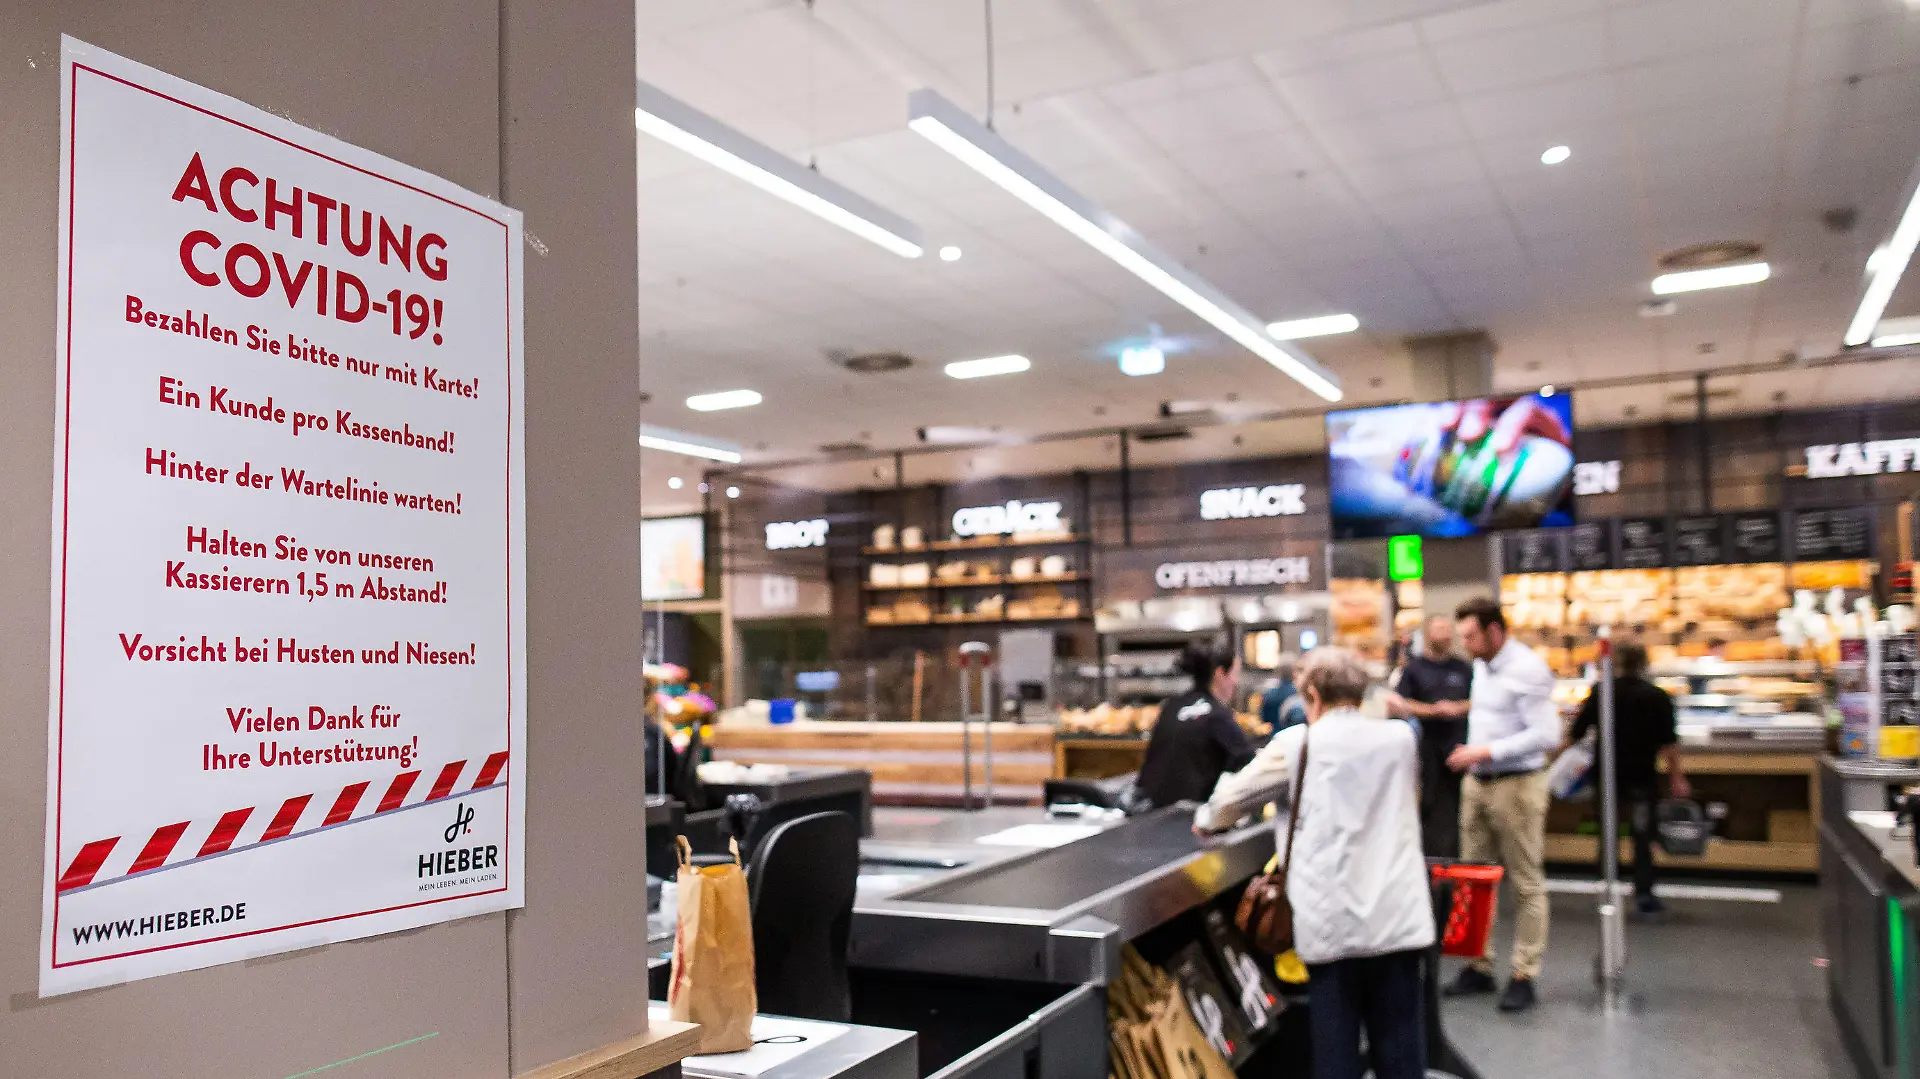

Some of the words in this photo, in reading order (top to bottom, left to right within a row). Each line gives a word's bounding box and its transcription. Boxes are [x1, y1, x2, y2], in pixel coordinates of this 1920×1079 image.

[172, 151, 448, 282] ACHTUNG
[179, 229, 444, 347] COVID-19!
[125, 294, 238, 347] Bezahlen
[246, 324, 281, 356] Sie
[288, 333, 340, 368] bitte
[346, 356, 380, 377] nur
[385, 362, 418, 387] mit
[423, 365, 479, 400] Karte!
[159, 375, 201, 409] Ein
[210, 385, 286, 425] Kunde
[292, 411, 329, 437] pro
[336, 409, 455, 455] Kassenband!
[1805, 438, 1920, 479] KAFF
[145, 447, 230, 484] Hinter
[235, 461, 274, 490] der
[280, 466, 389, 506] Wartelinie
[393, 491, 462, 515] warten!
[186, 525, 267, 559] Halten
[274, 534, 309, 562] Sie
[314, 548, 352, 567] von
[357, 552, 434, 573] unseren
[165, 560, 290, 595] Kassierern
[296, 571, 329, 603] 1,5
[335, 583, 355, 599] m
[359, 575, 447, 604] Abstand!
[118, 632, 227, 663] Vorsicht
[235, 636, 269, 663] bei
[277, 637, 355, 665] Husten
[361, 640, 399, 665] und
[406, 641, 476, 665] Niesen!
[225, 706, 300, 734] Vielen
[308, 705, 365, 731] Dank
[370, 704, 401, 729] für
[203, 743, 251, 771] Ihre
[259, 735, 418, 769] Unterstützung!
[418, 844, 498, 879] HIEBER
[418, 883, 435, 892] MEIN
[436, 880, 457, 889] LEBEN.
[459, 877, 476, 885] MEIN
[477, 873, 498, 882] LADEN.
[72, 902, 246, 946] WWW.HIEBER.DE
